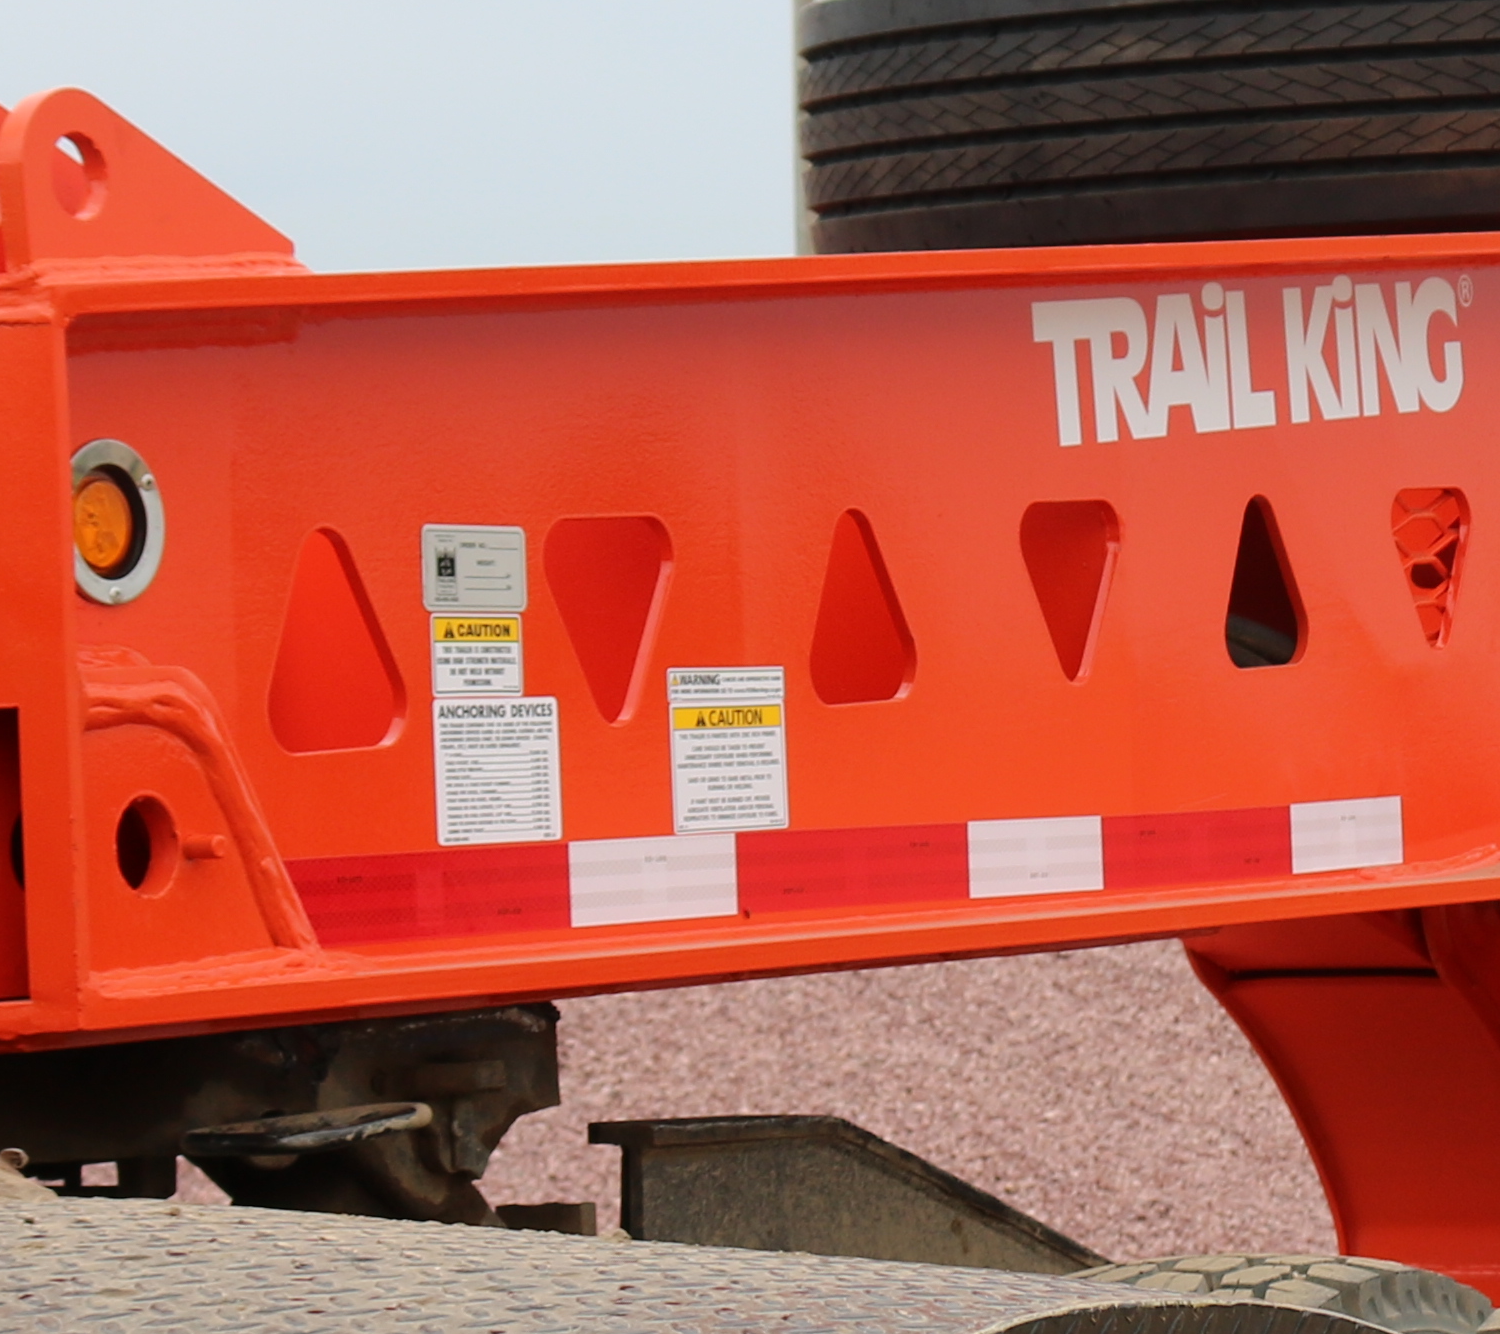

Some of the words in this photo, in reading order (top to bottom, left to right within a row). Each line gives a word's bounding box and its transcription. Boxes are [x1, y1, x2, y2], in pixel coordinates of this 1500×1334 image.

[457, 623, 511, 637] CAUTION
[679, 673, 721, 686] WARNING
[438, 704, 507, 719] ANCHORING
[510, 703, 554, 717] DEVICES
[708, 709, 763, 727] CAUTION
